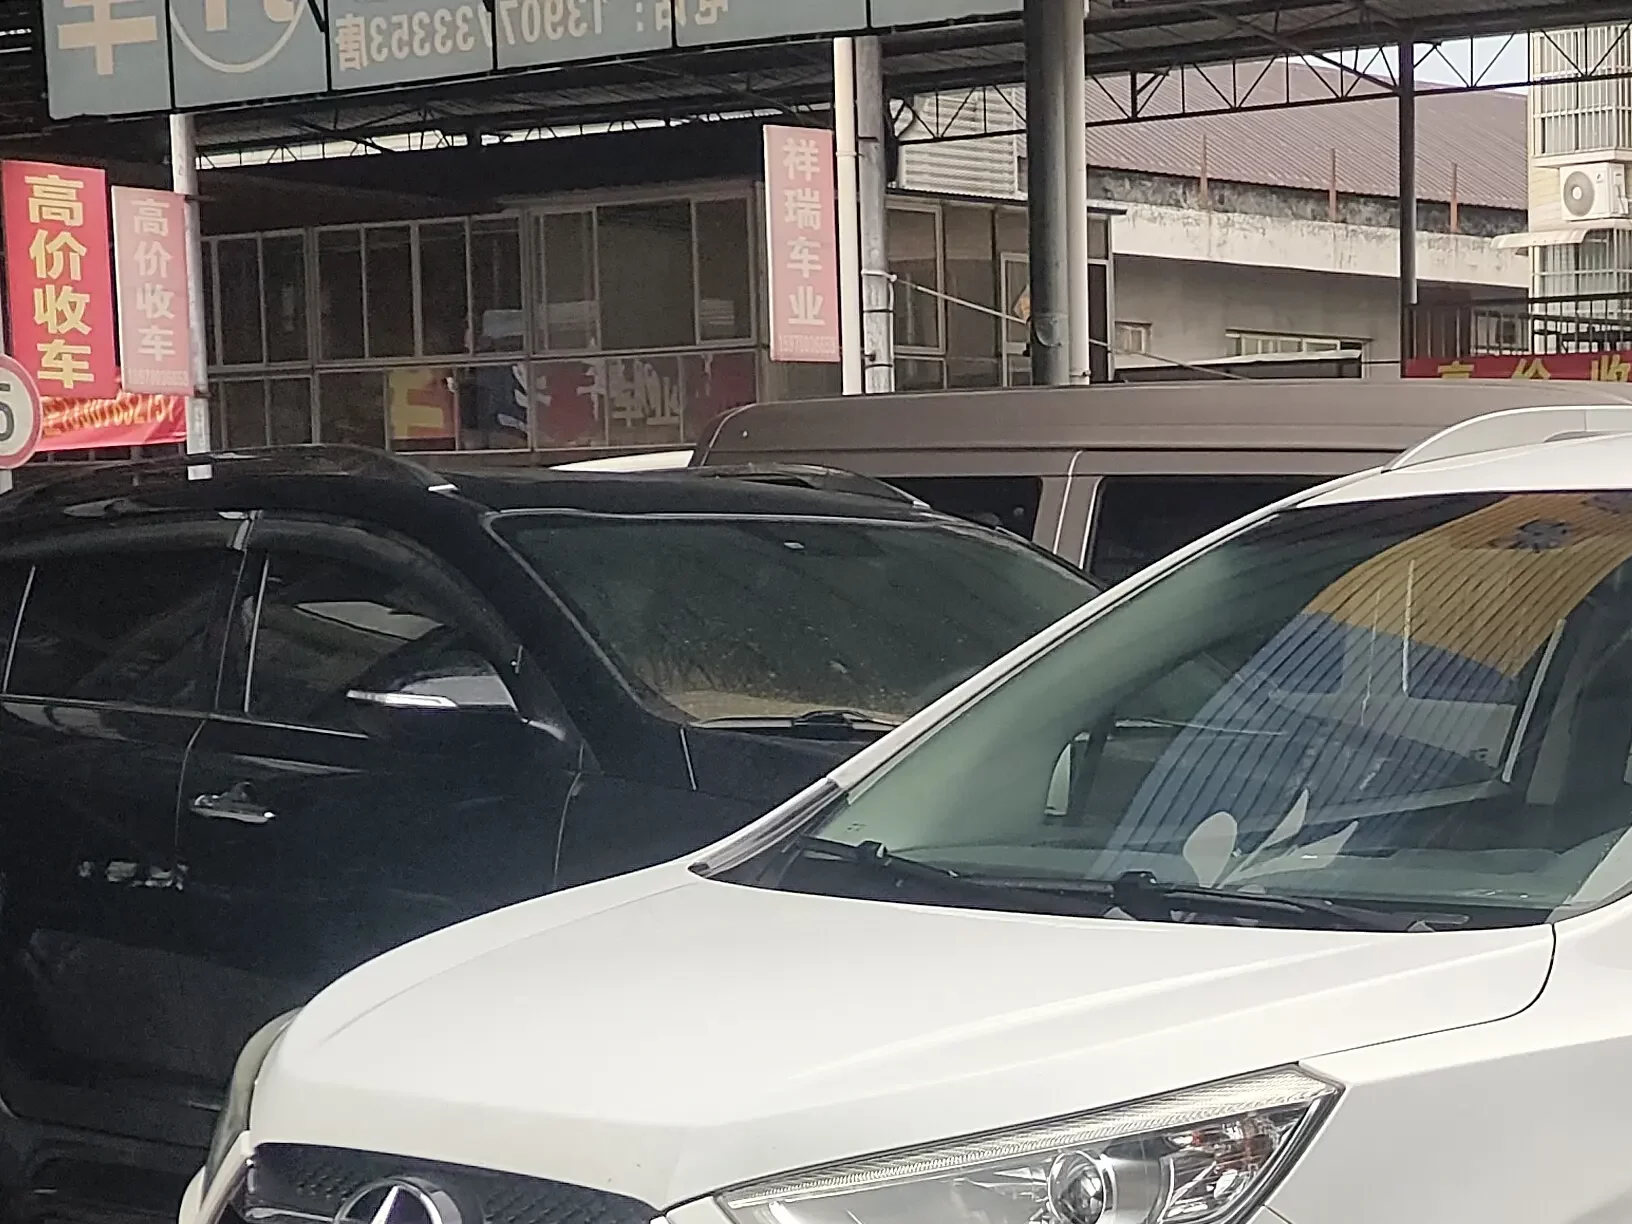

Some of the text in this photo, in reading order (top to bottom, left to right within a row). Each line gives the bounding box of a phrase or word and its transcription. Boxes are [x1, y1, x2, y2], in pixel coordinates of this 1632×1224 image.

[24, 174, 95, 389] 高价收车
[131, 198, 177, 362] 高价收车
[781, 137, 826, 327] 祥瑞车业
